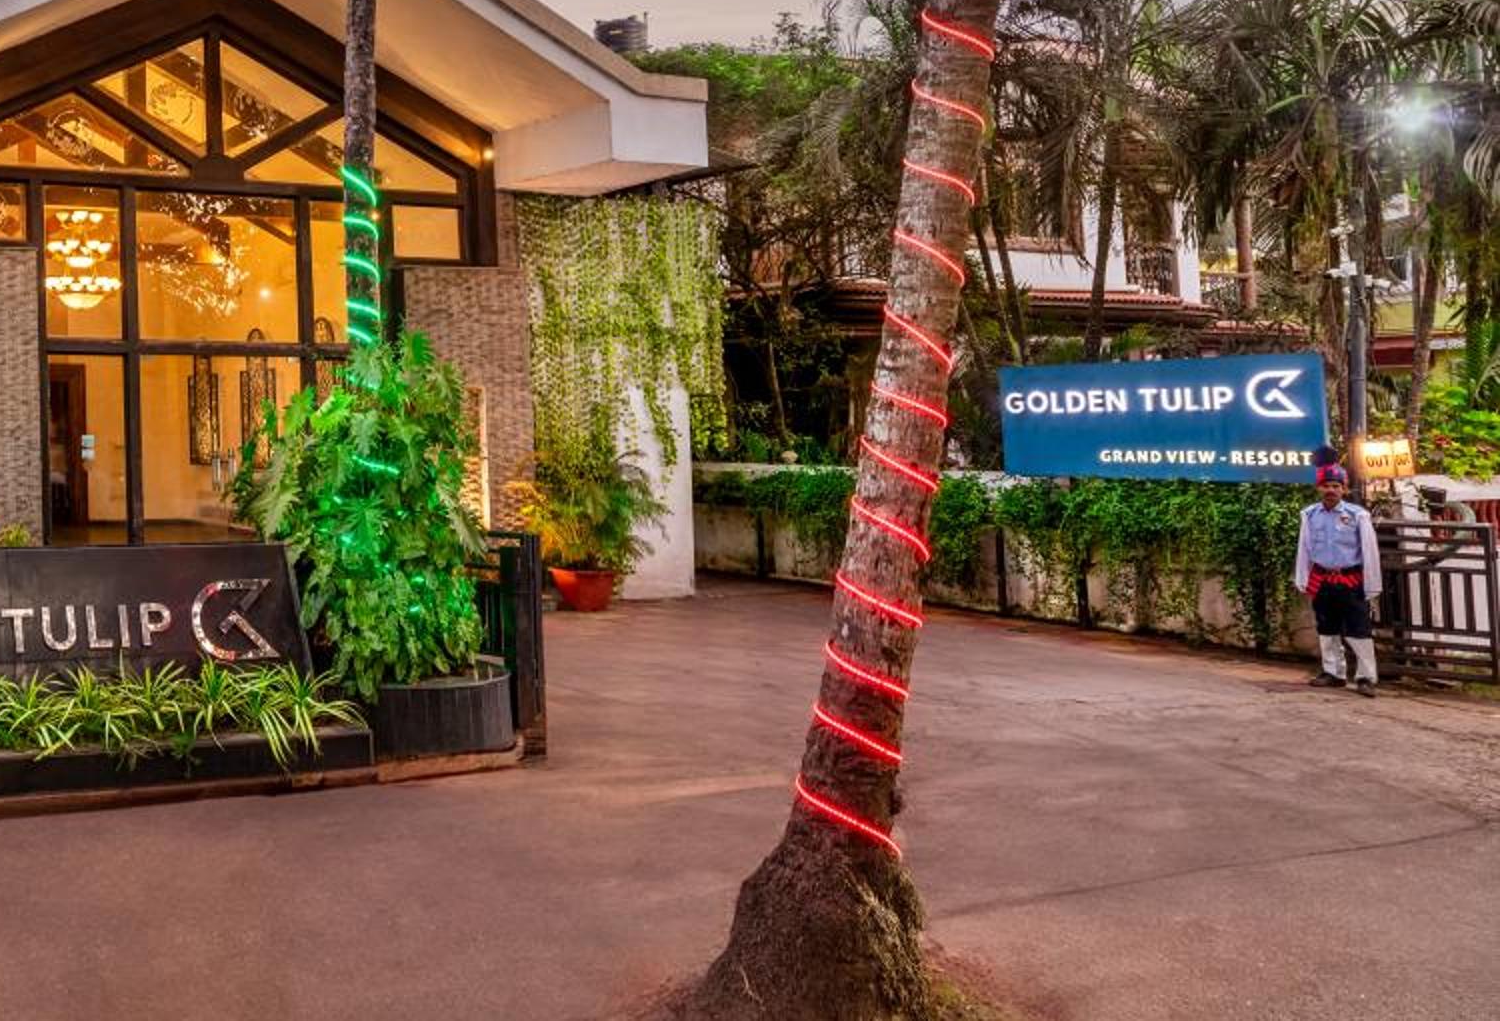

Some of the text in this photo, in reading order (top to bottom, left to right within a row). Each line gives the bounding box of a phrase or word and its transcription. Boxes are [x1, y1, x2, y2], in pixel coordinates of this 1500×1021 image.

[1005, 386, 1233, 414] GOLDEN TULIP
[1100, 450, 1162, 463] GRAND
[1165, 450, 1215, 464] VIEW
[1231, 450, 1314, 465] RESORT
[1365, 454, 1389, 467] OUT
[1, 602, 172, 653] TULIP
